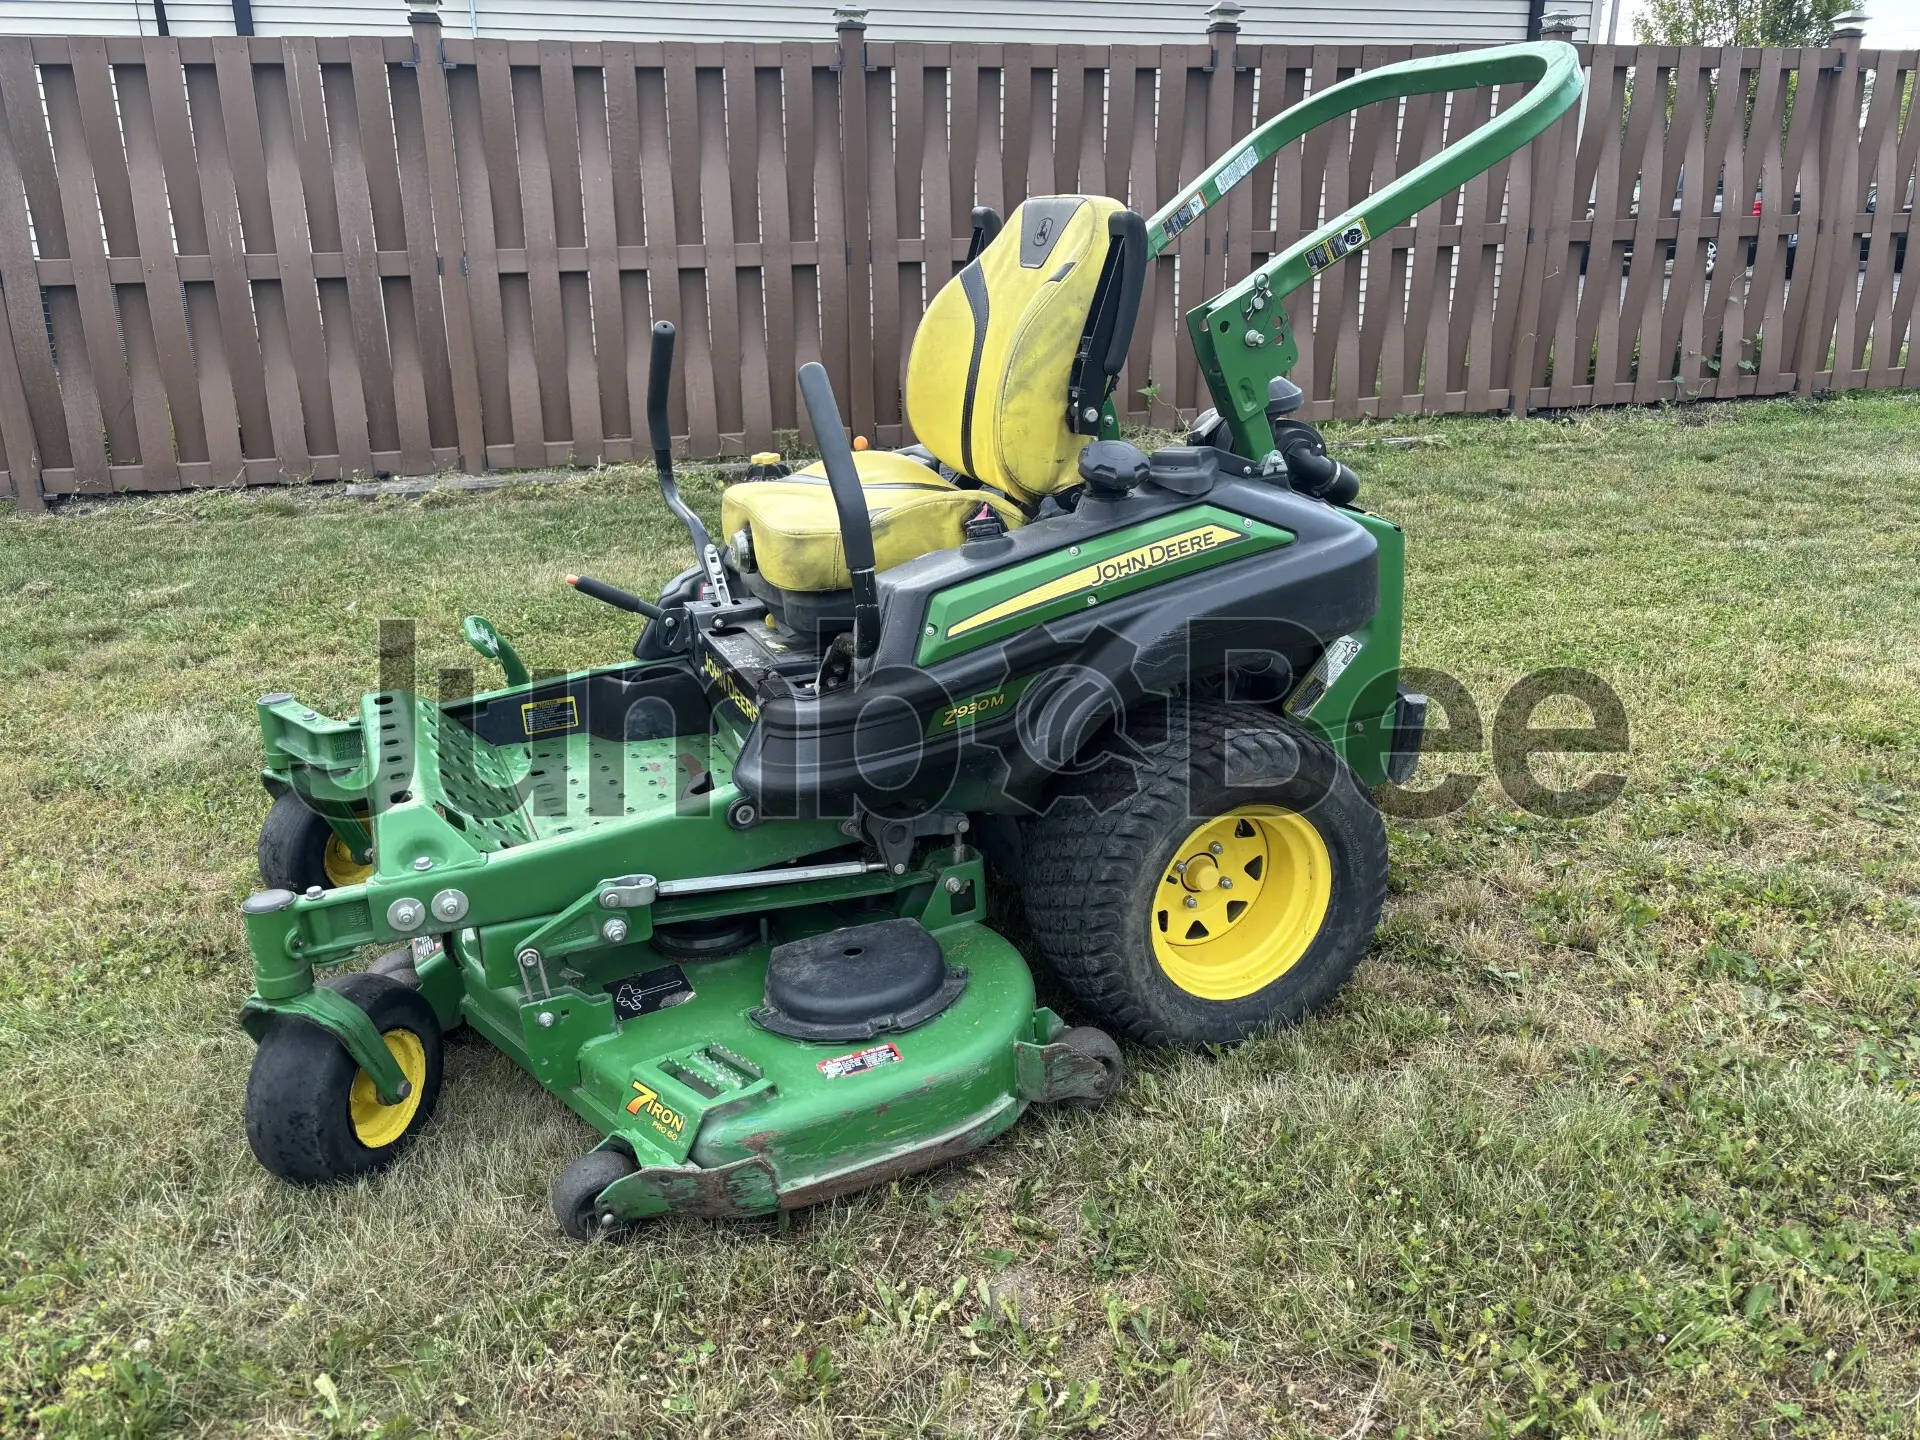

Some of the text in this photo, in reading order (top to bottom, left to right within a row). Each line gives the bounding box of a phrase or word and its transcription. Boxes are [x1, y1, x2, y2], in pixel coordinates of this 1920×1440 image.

[1091, 531, 1218, 586] JOHN DEERE
[704, 651, 727, 692] JOHN
[942, 693, 1005, 727] Z930M
[645, 1098, 685, 1133] IRON
[651, 1120, 678, 1141] PRO 60
